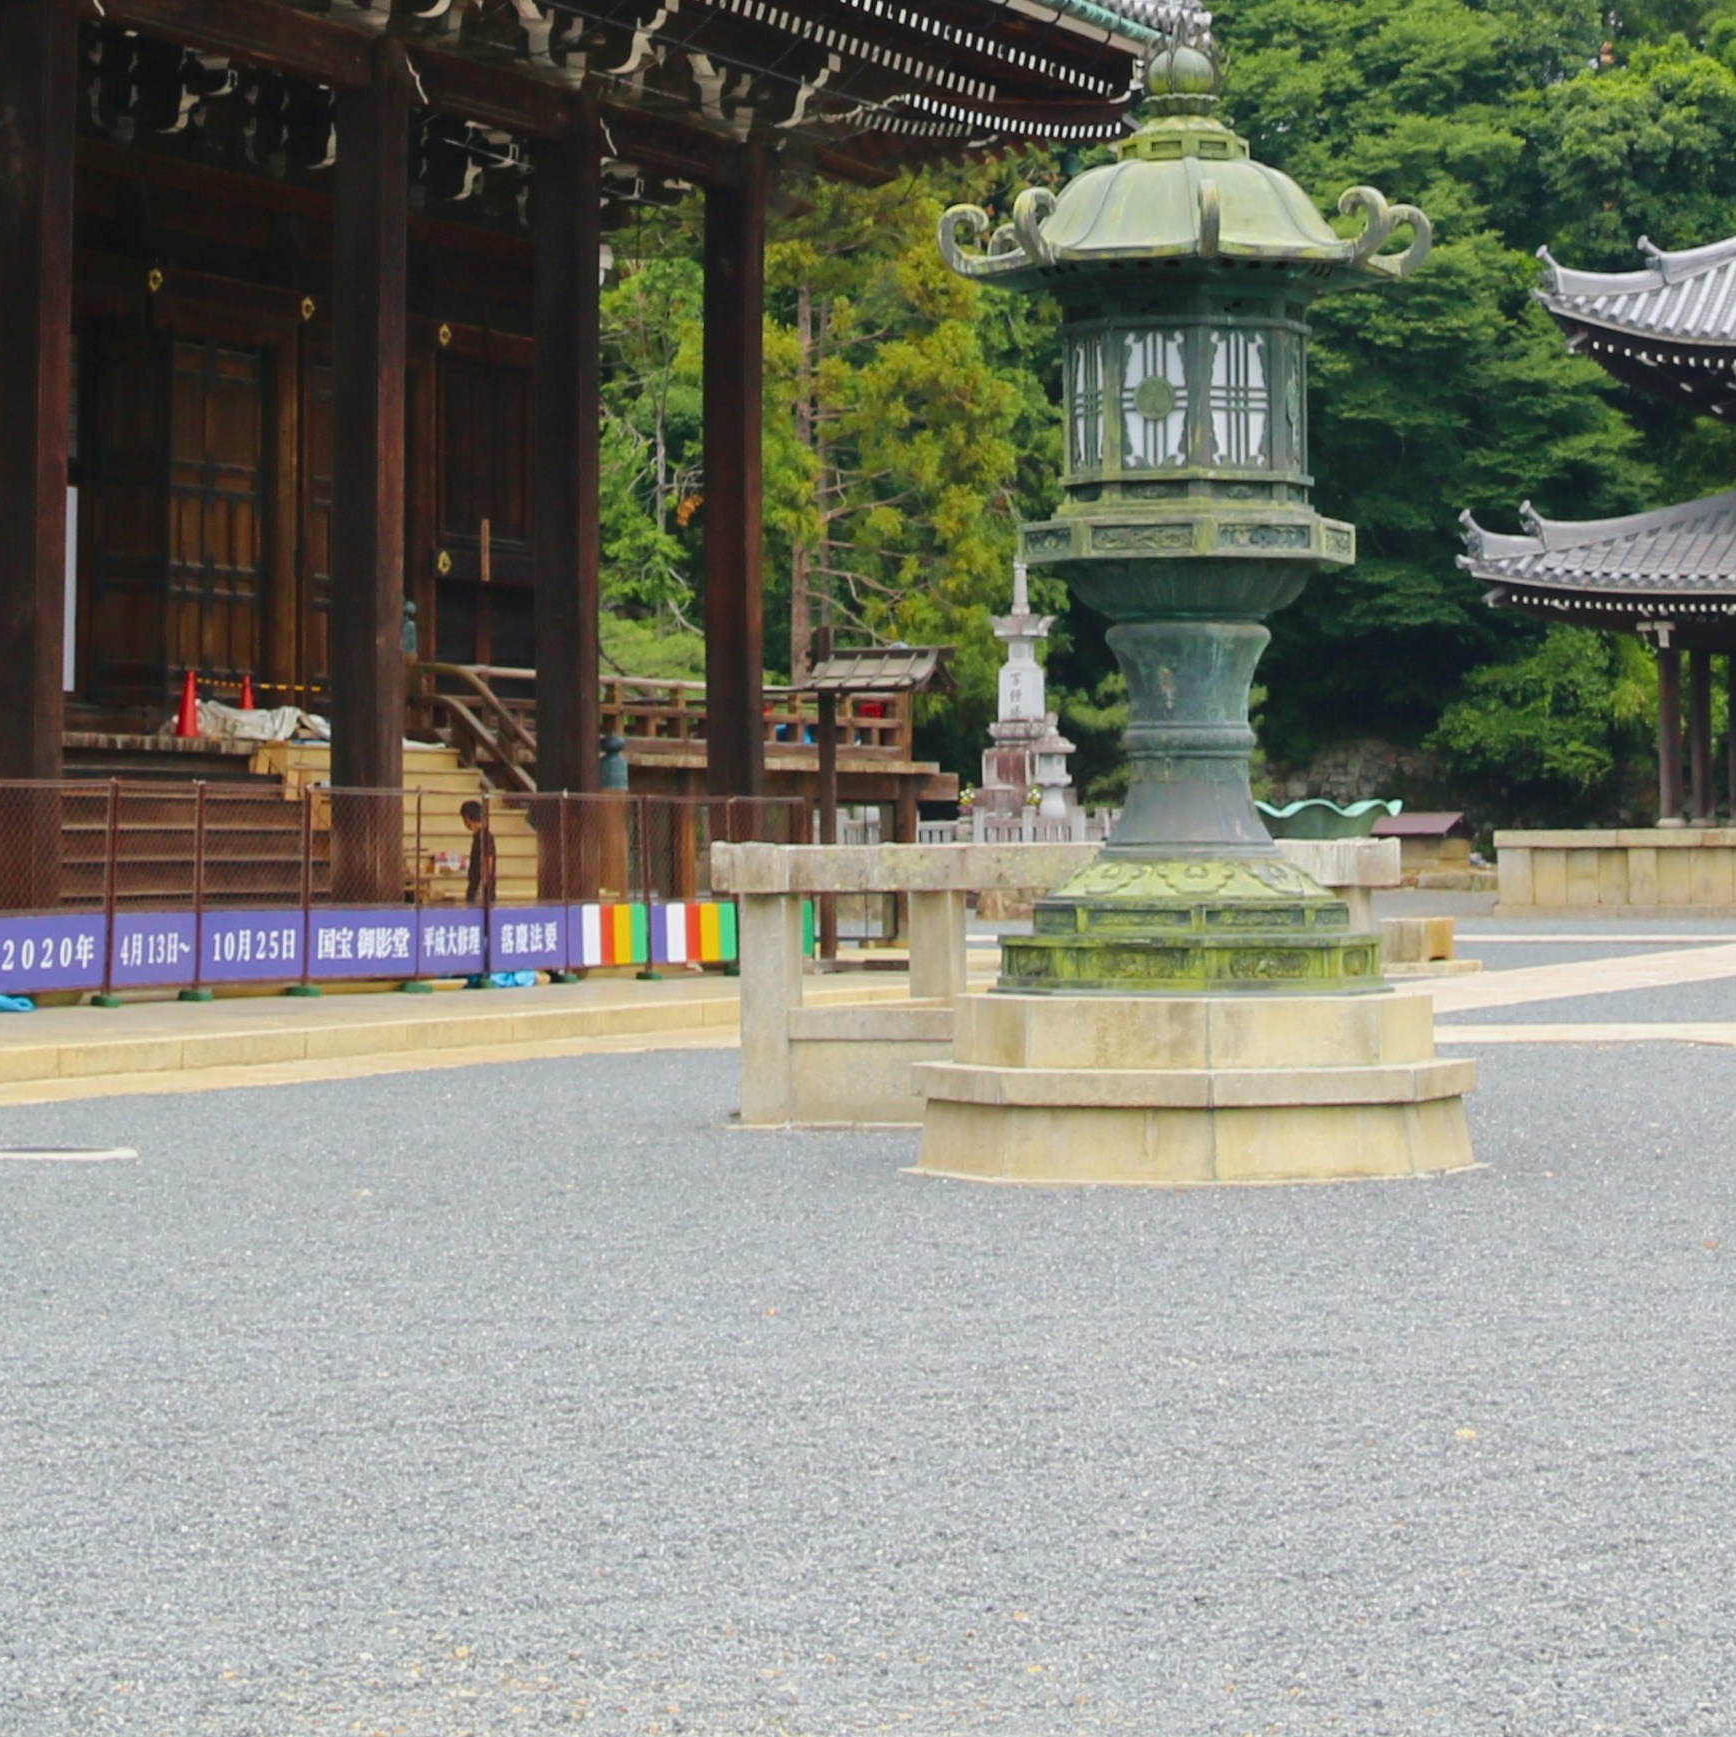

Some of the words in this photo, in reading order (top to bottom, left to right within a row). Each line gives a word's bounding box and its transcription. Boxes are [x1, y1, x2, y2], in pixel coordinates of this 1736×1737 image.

[1, 933, 94, 970] 2020年
[213, 928, 296, 962] 10月25日
[317, 927, 353, 960] 国宝
[357, 926, 411, 959] 御影堂
[423, 924, 481, 957] 平成大修理
[501, 921, 558, 954] 落慶法要
